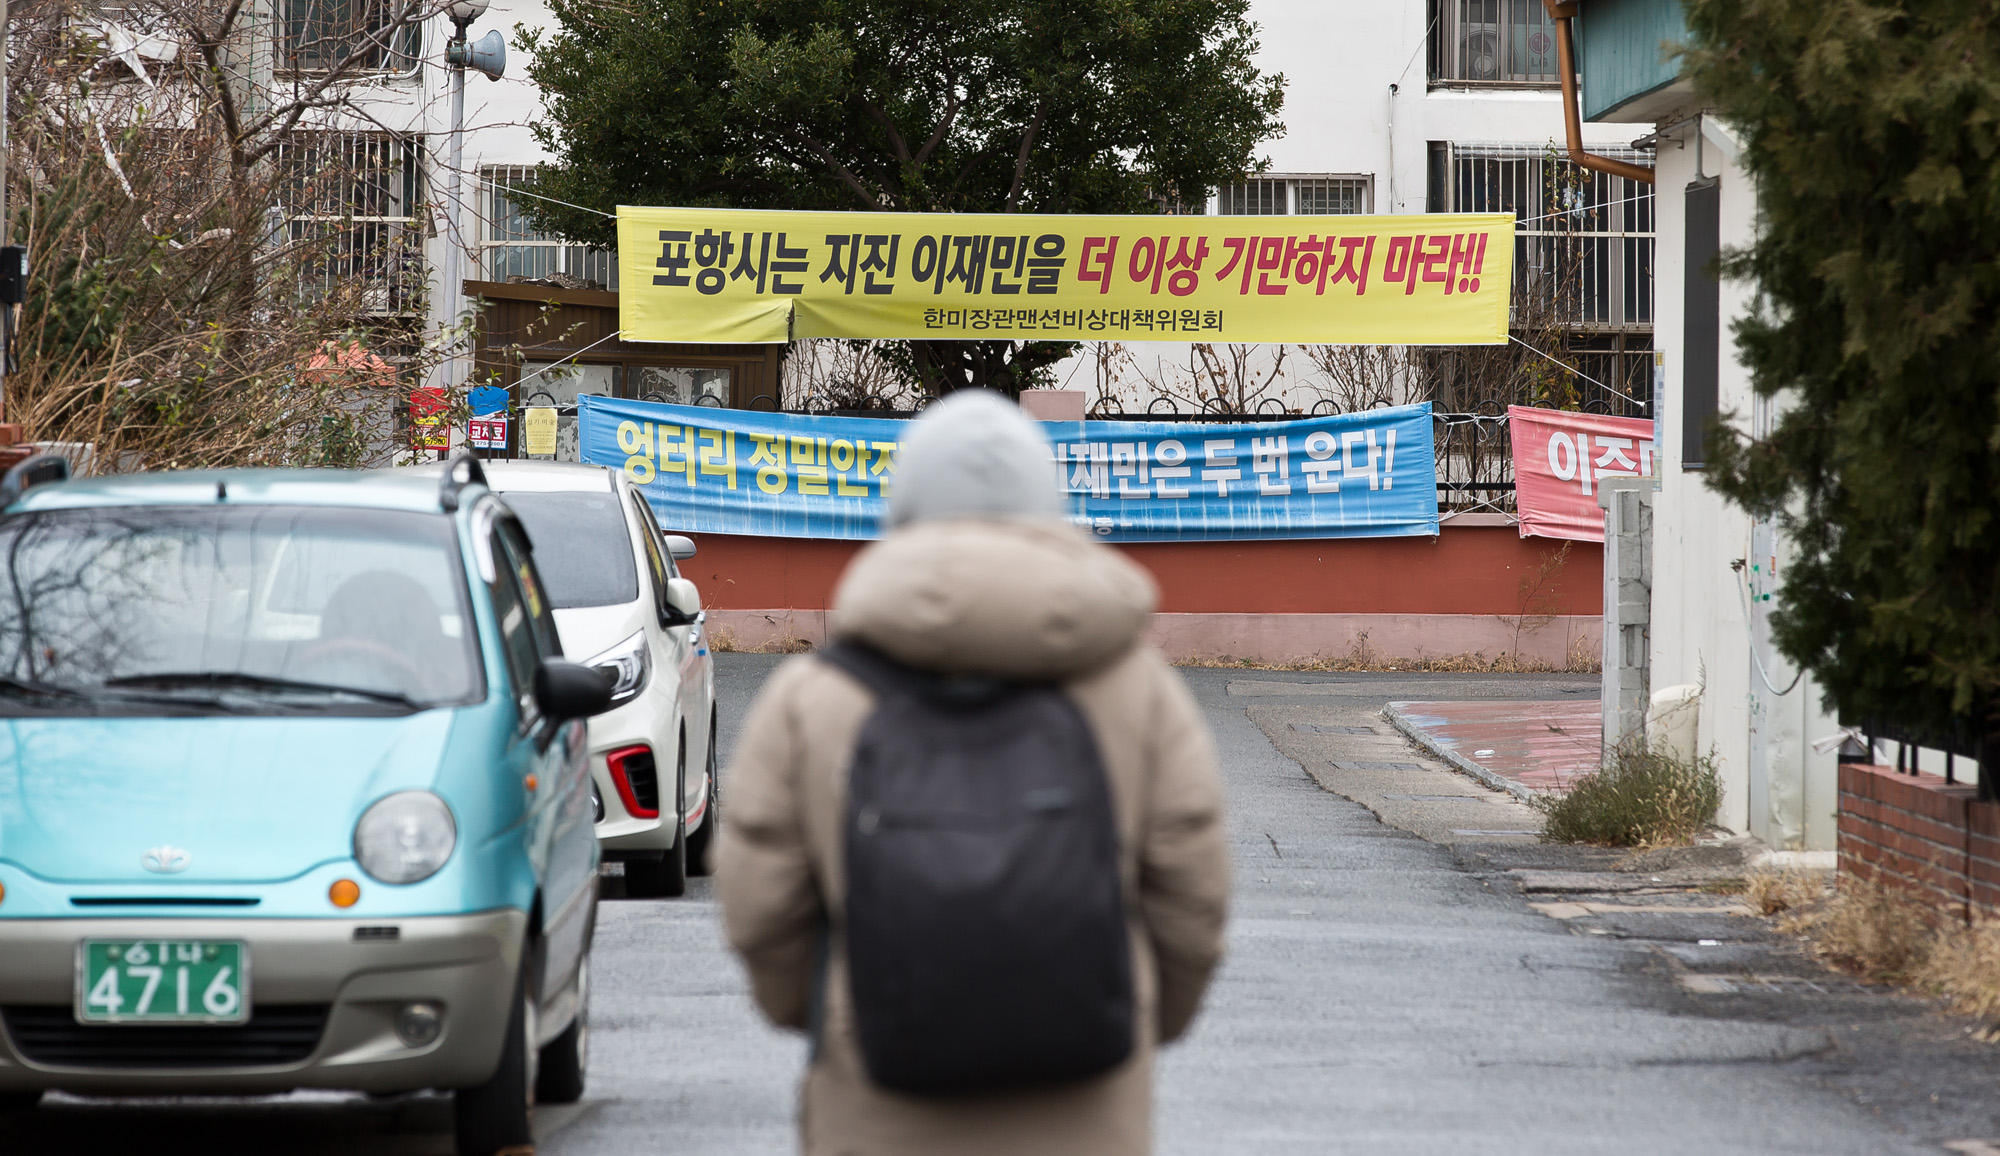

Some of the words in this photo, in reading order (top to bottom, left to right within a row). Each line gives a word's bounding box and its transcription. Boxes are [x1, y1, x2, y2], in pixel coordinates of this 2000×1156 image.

[1531, 57, 1548, 67] LG
[652, 228, 810, 295] 포항시는
[819, 233, 902, 295] 지진
[911, 233, 1067, 295] 이재민을
[1077, 235, 1120, 295] 더
[1128, 235, 1210, 297] 이상
[1215, 234, 1377, 296] 기만하지
[1383, 232, 1488, 296] 마라!!
[923, 307, 1224, 333] 한미장관맨션비상대책위원회
[471, 425, 504, 440] 교차로
[616, 420, 737, 491] 엉터리
[1201, 439, 1241, 498] 두
[1251, 435, 1291, 497] 번
[1301, 429, 1397, 495] 운다!
[87, 965, 240, 1016] 4716
